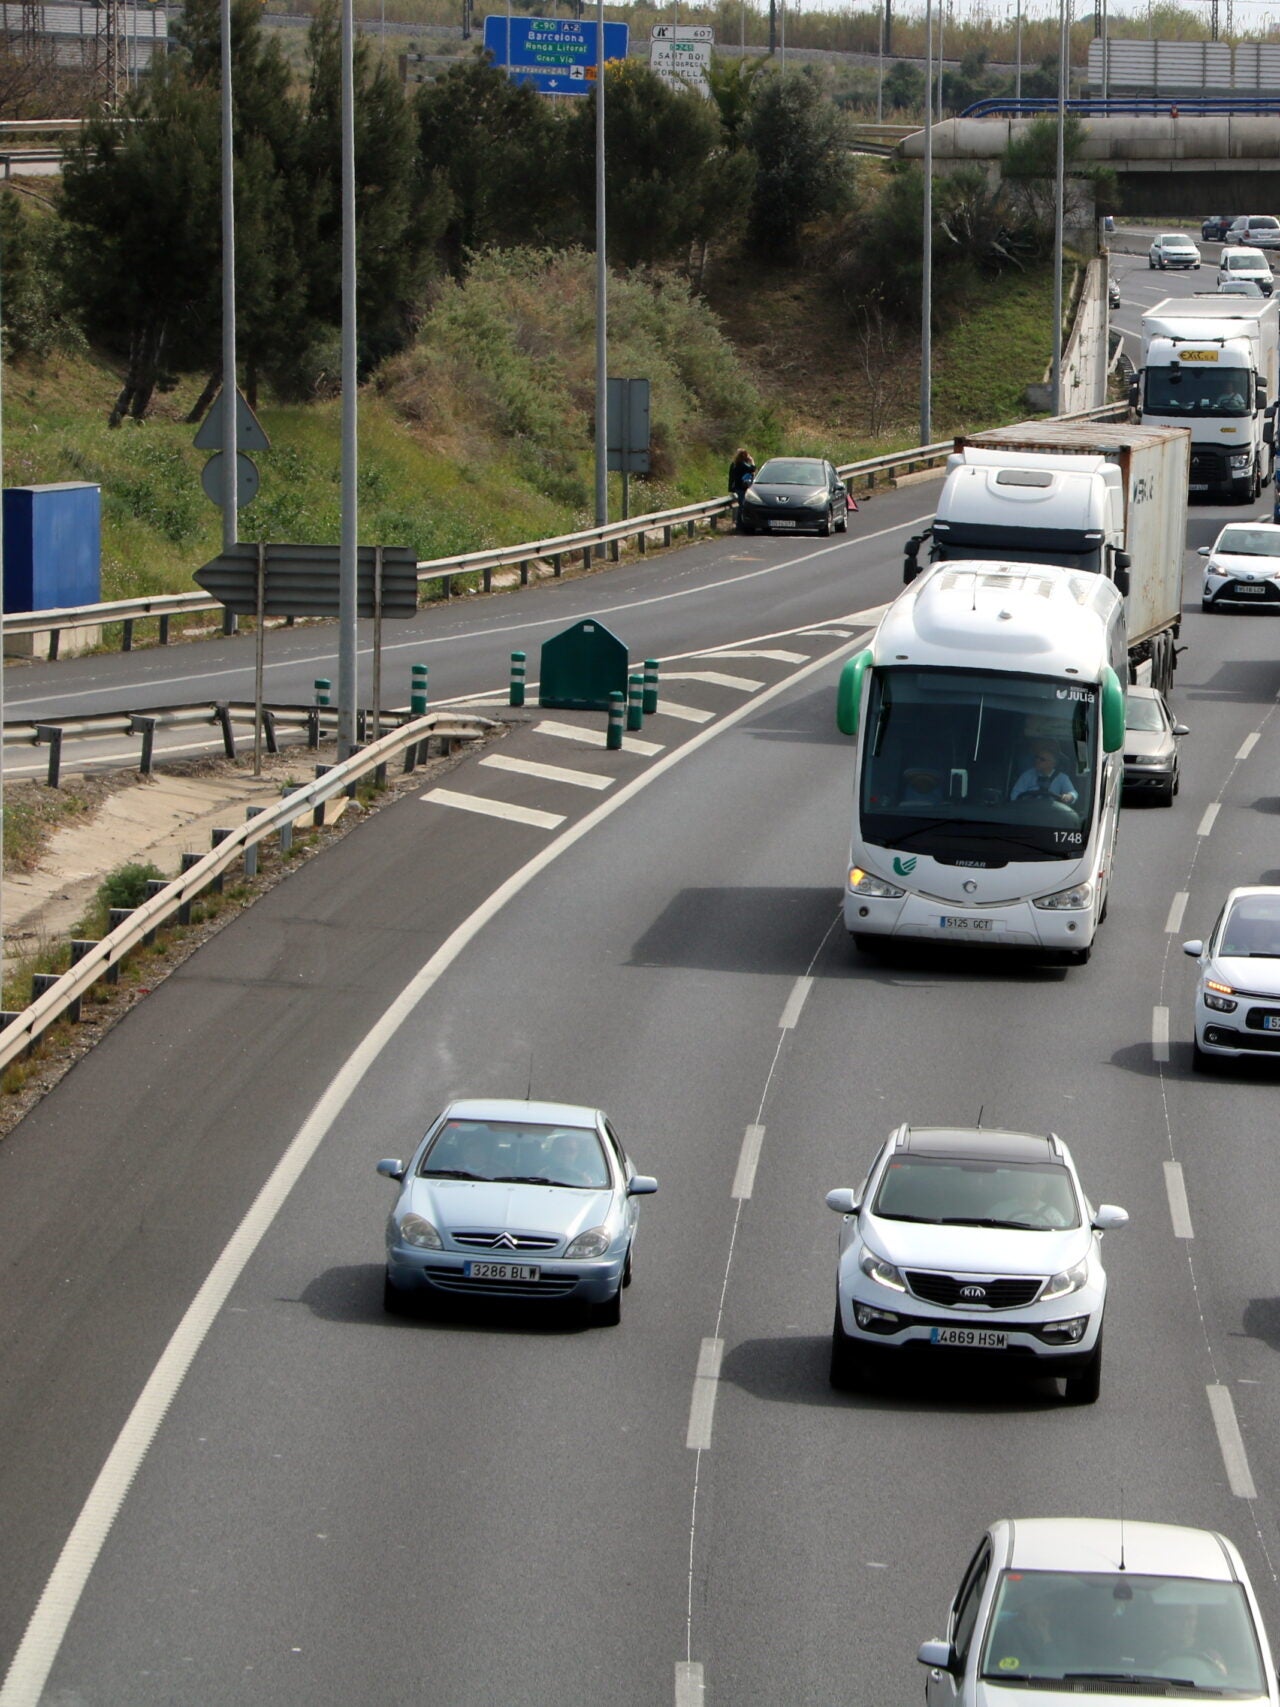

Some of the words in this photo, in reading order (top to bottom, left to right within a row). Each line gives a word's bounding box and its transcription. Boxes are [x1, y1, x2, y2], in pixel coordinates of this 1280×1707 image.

[533, 21, 556, 30] E-90
[563, 23, 580, 32] A-2
[528, 31, 584, 43] Barcelona
[525, 42, 553, 51] Ronda
[557, 43, 587, 53] Litoral
[688, 53, 704, 61] BOI
[1053, 831, 1082, 844] 1748
[955, 860, 986, 868] IRIZAR
[947, 918, 969, 928] 5125
[973, 920, 990, 929] GCT
[473, 1264, 507, 1278] 3286
[511, 1266, 537, 1280] BLW
[964, 1288, 981, 1297] KIA
[940, 1330, 975, 1345] 4869
[978, 1332, 1005, 1346] HSM
